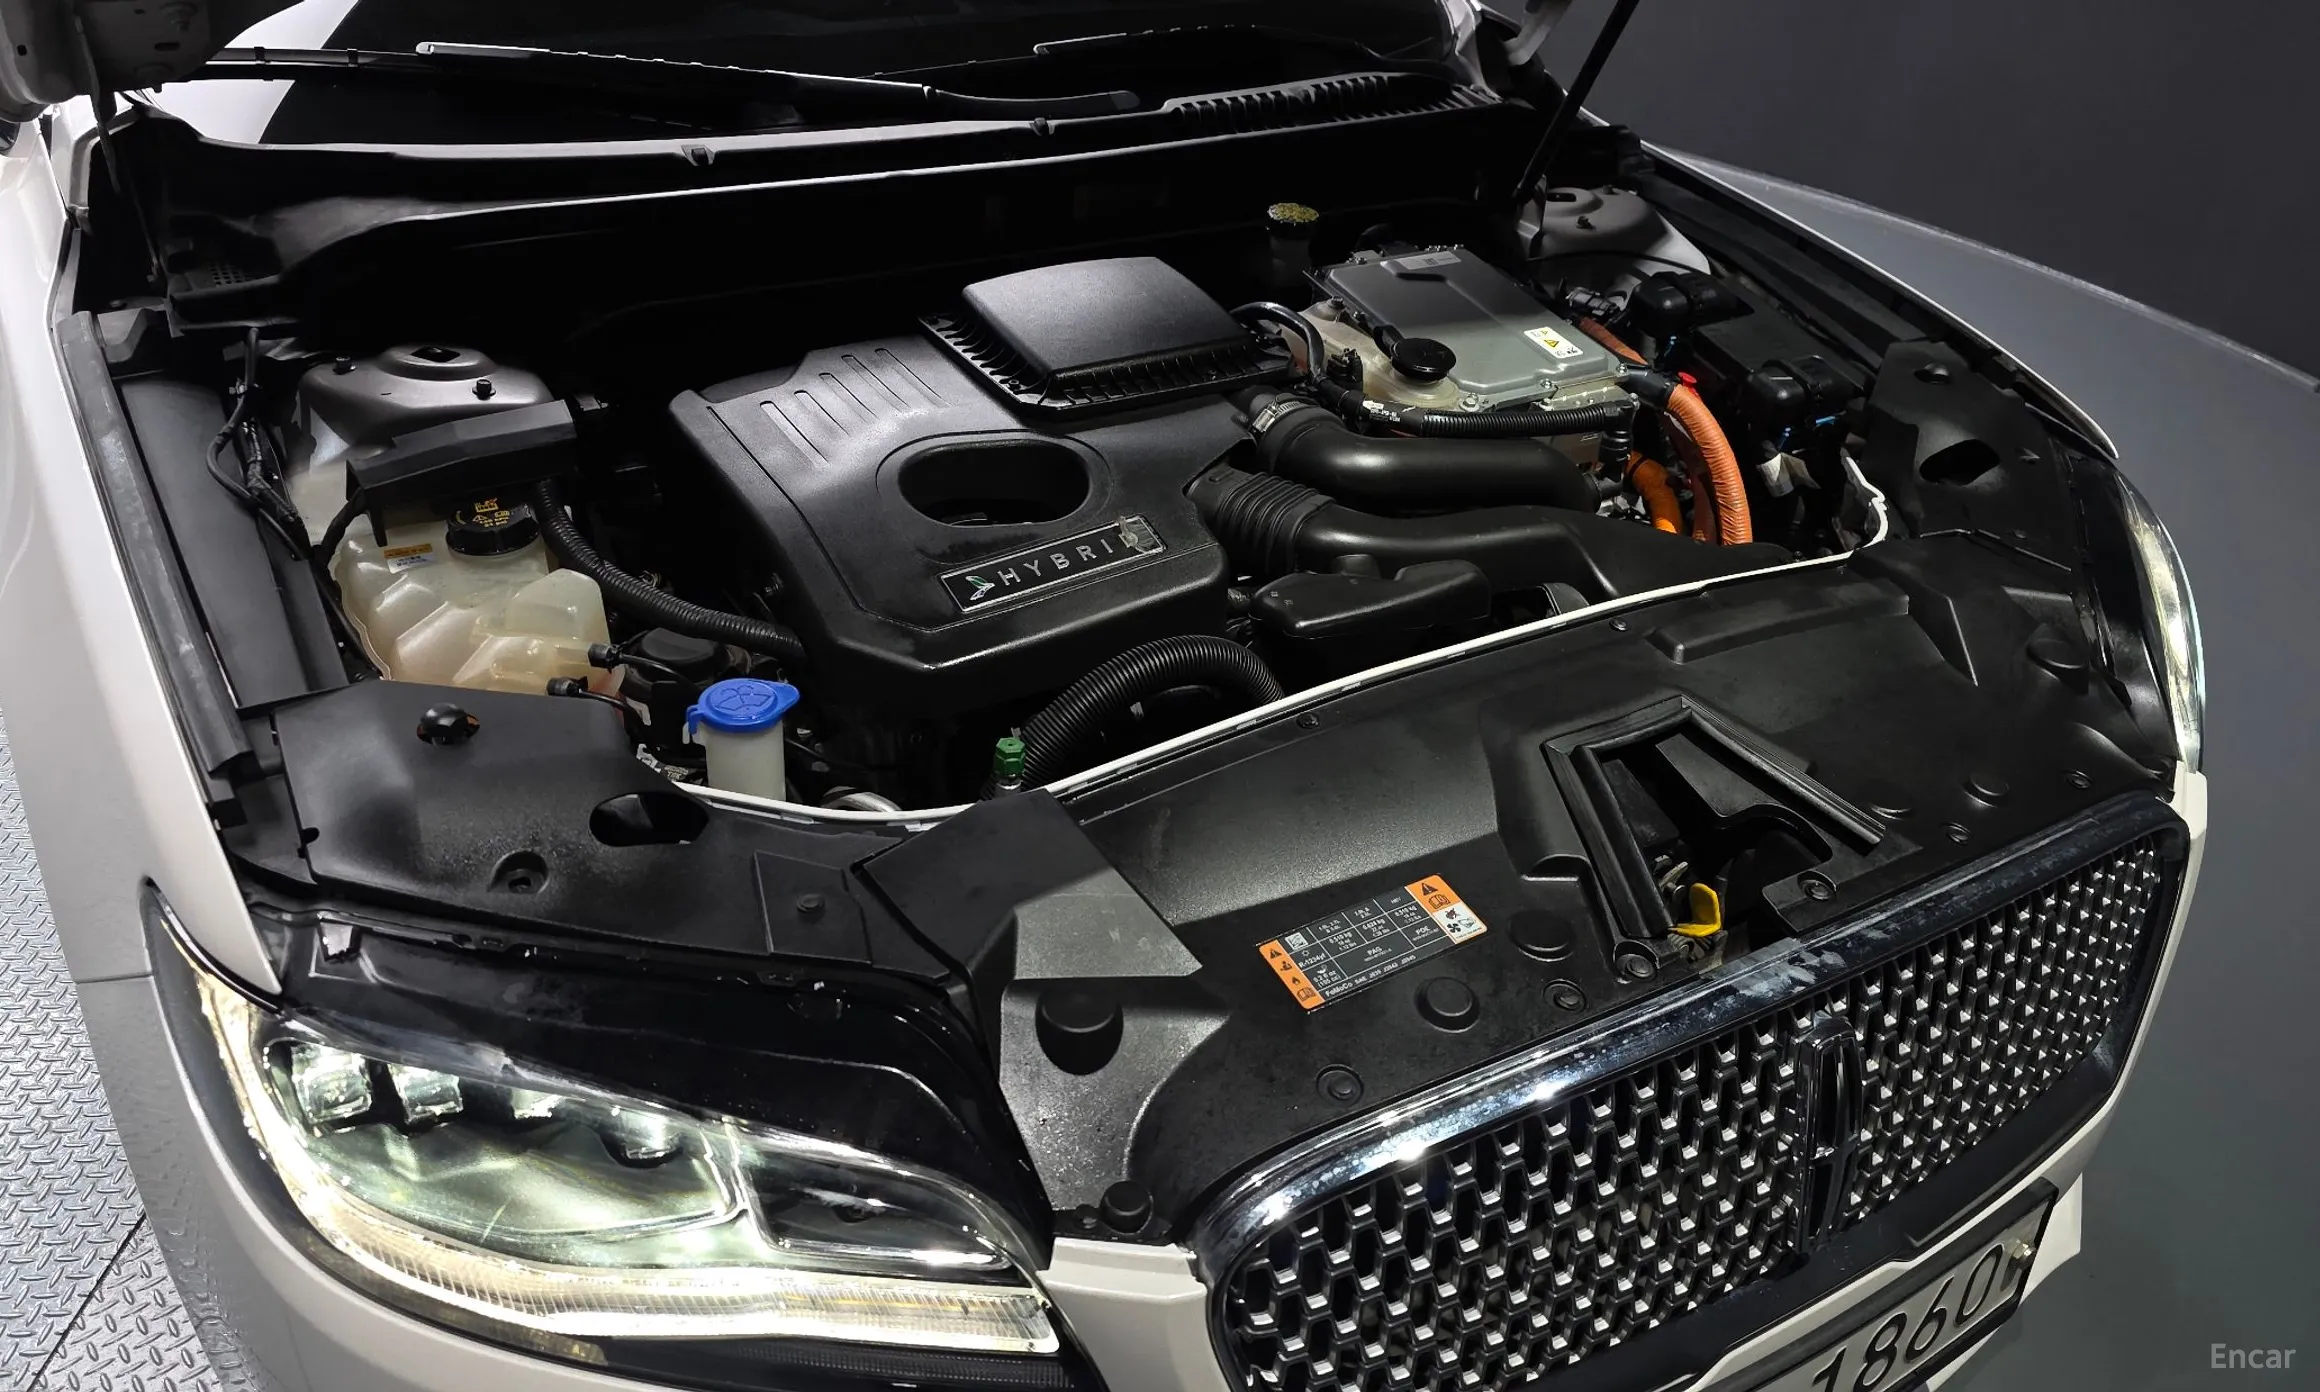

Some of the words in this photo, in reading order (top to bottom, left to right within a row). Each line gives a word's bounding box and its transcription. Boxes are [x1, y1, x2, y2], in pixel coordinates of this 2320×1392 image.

[1367, 947, 1383, 955] PAG
[1298, 953, 1326, 967] R-1234yf
[1325, 982, 1353, 997] FoMoCo
[1812, 1243, 2003, 1392] 1860
